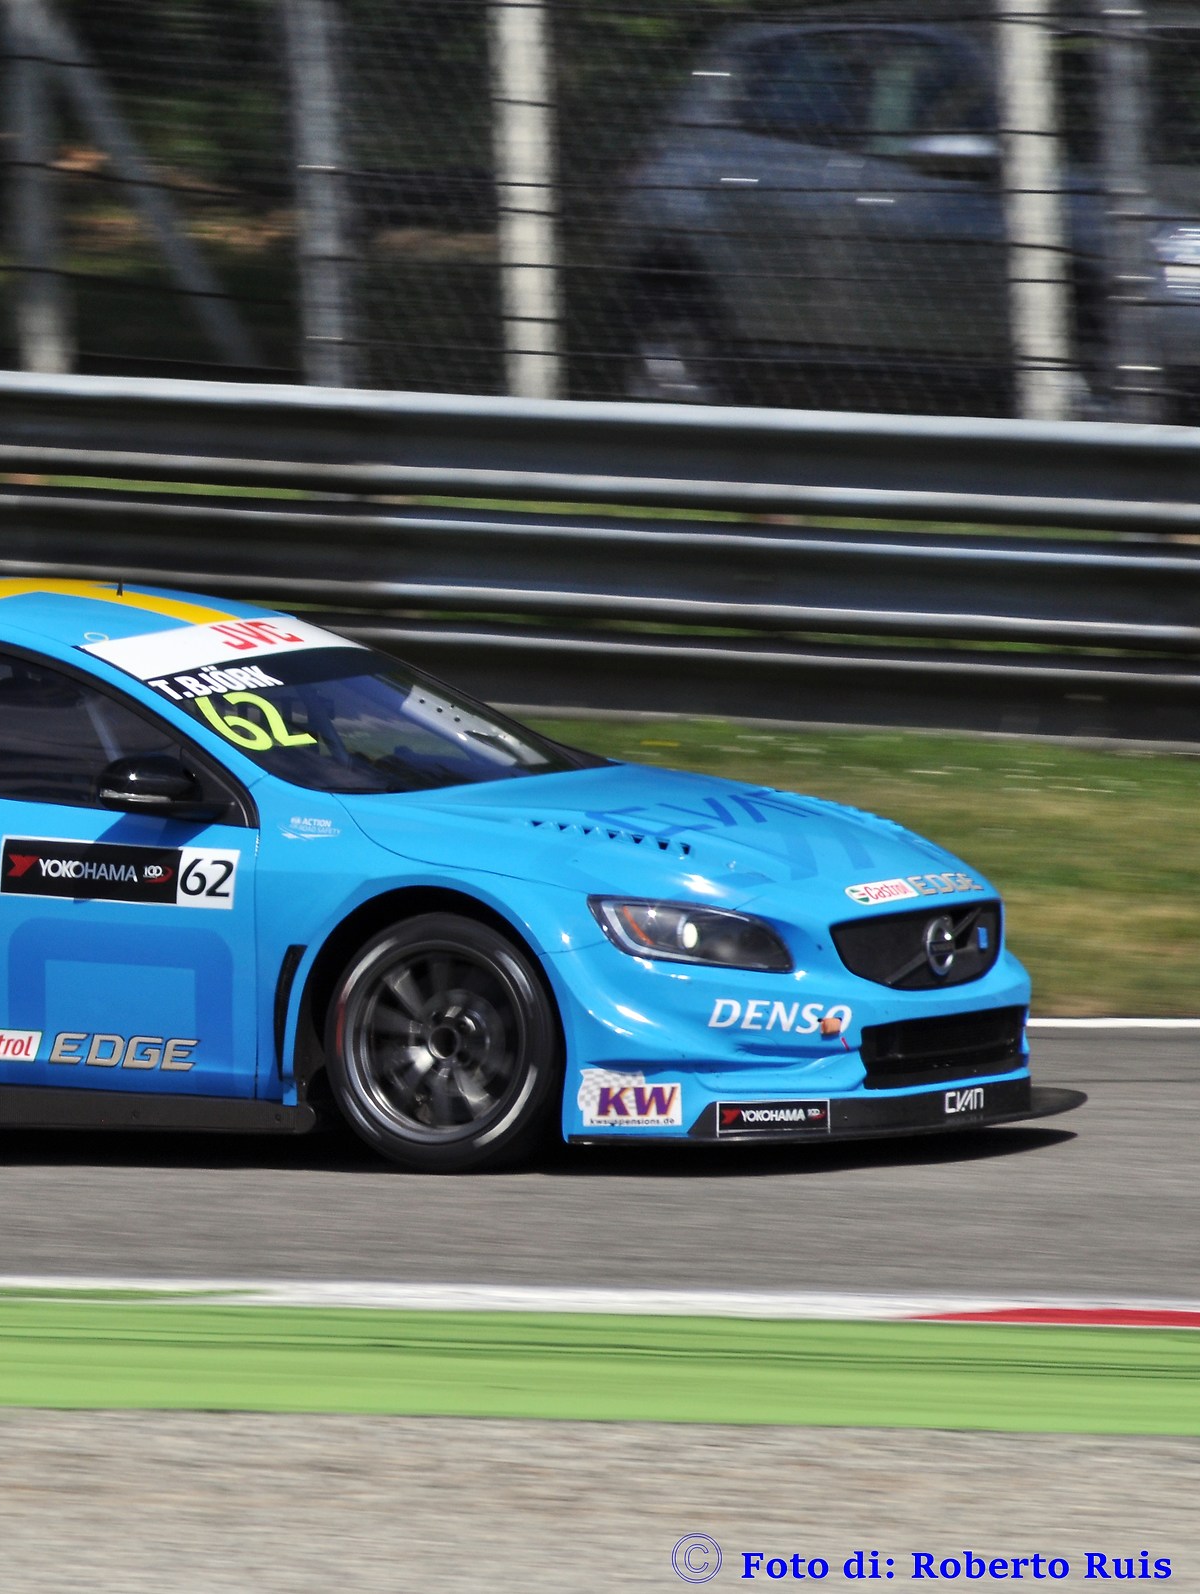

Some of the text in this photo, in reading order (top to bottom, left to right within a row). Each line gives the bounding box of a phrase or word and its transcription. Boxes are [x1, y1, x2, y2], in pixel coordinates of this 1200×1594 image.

[209, 620, 304, 650] JVC
[147, 664, 285, 700] T.BJÖRK
[194, 691, 318, 751] 62
[38, 858, 138, 882] YOKOHAMA
[179, 858, 234, 897] 62
[863, 872, 985, 900] Castrol EDGE
[708, 999, 853, 1034] DENSO
[49, 1031, 200, 1071] EDGE
[597, 1086, 679, 1117] KW
[741, 1108, 806, 1122] YOKOHAMA
